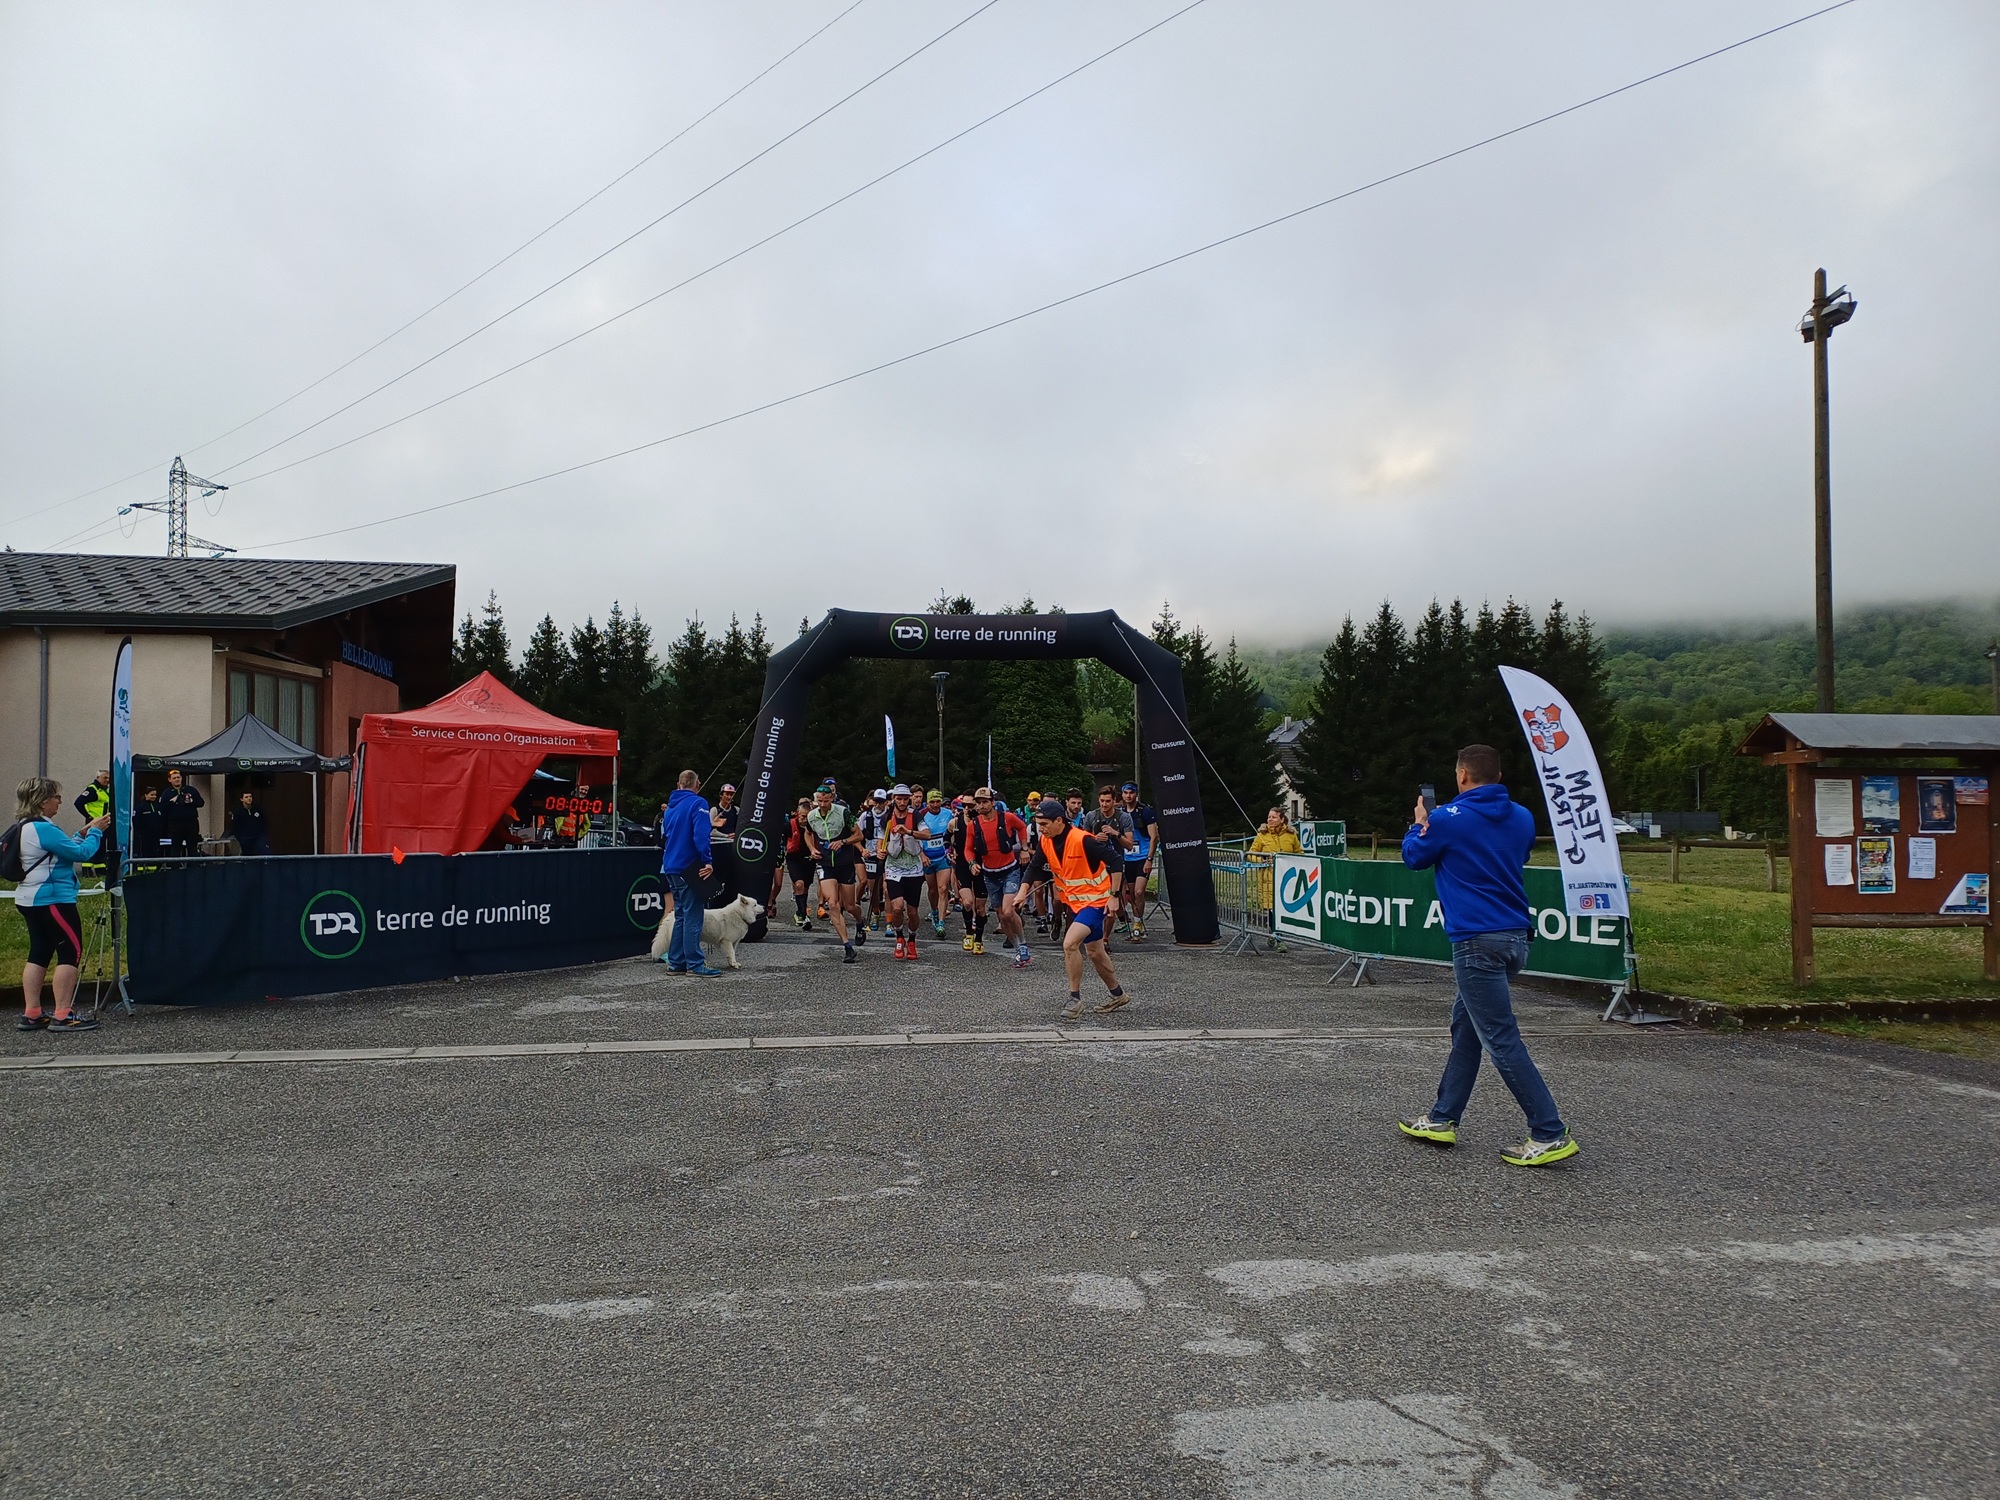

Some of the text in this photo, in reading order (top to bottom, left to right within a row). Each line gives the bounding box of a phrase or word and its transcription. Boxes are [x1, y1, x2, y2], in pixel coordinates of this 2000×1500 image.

[894, 626, 1057, 644] TDR terre de running
[342, 641, 394, 678] BELLEDONNE
[411, 726, 576, 746] Service Chrono Organisation
[1151, 739, 1186, 750] Chaussures
[740, 716, 785, 853] TDR terre de running
[1162, 773, 1185, 782] Textile
[545, 796, 613, 814] 08:00:01
[1162, 806, 1195, 816] Diététique
[1165, 839, 1202, 850] Electronique
[631, 892, 664, 911] TDR
[1324, 888, 1414, 927] CRÉDIT
[309, 900, 551, 936] TDR terre de running
